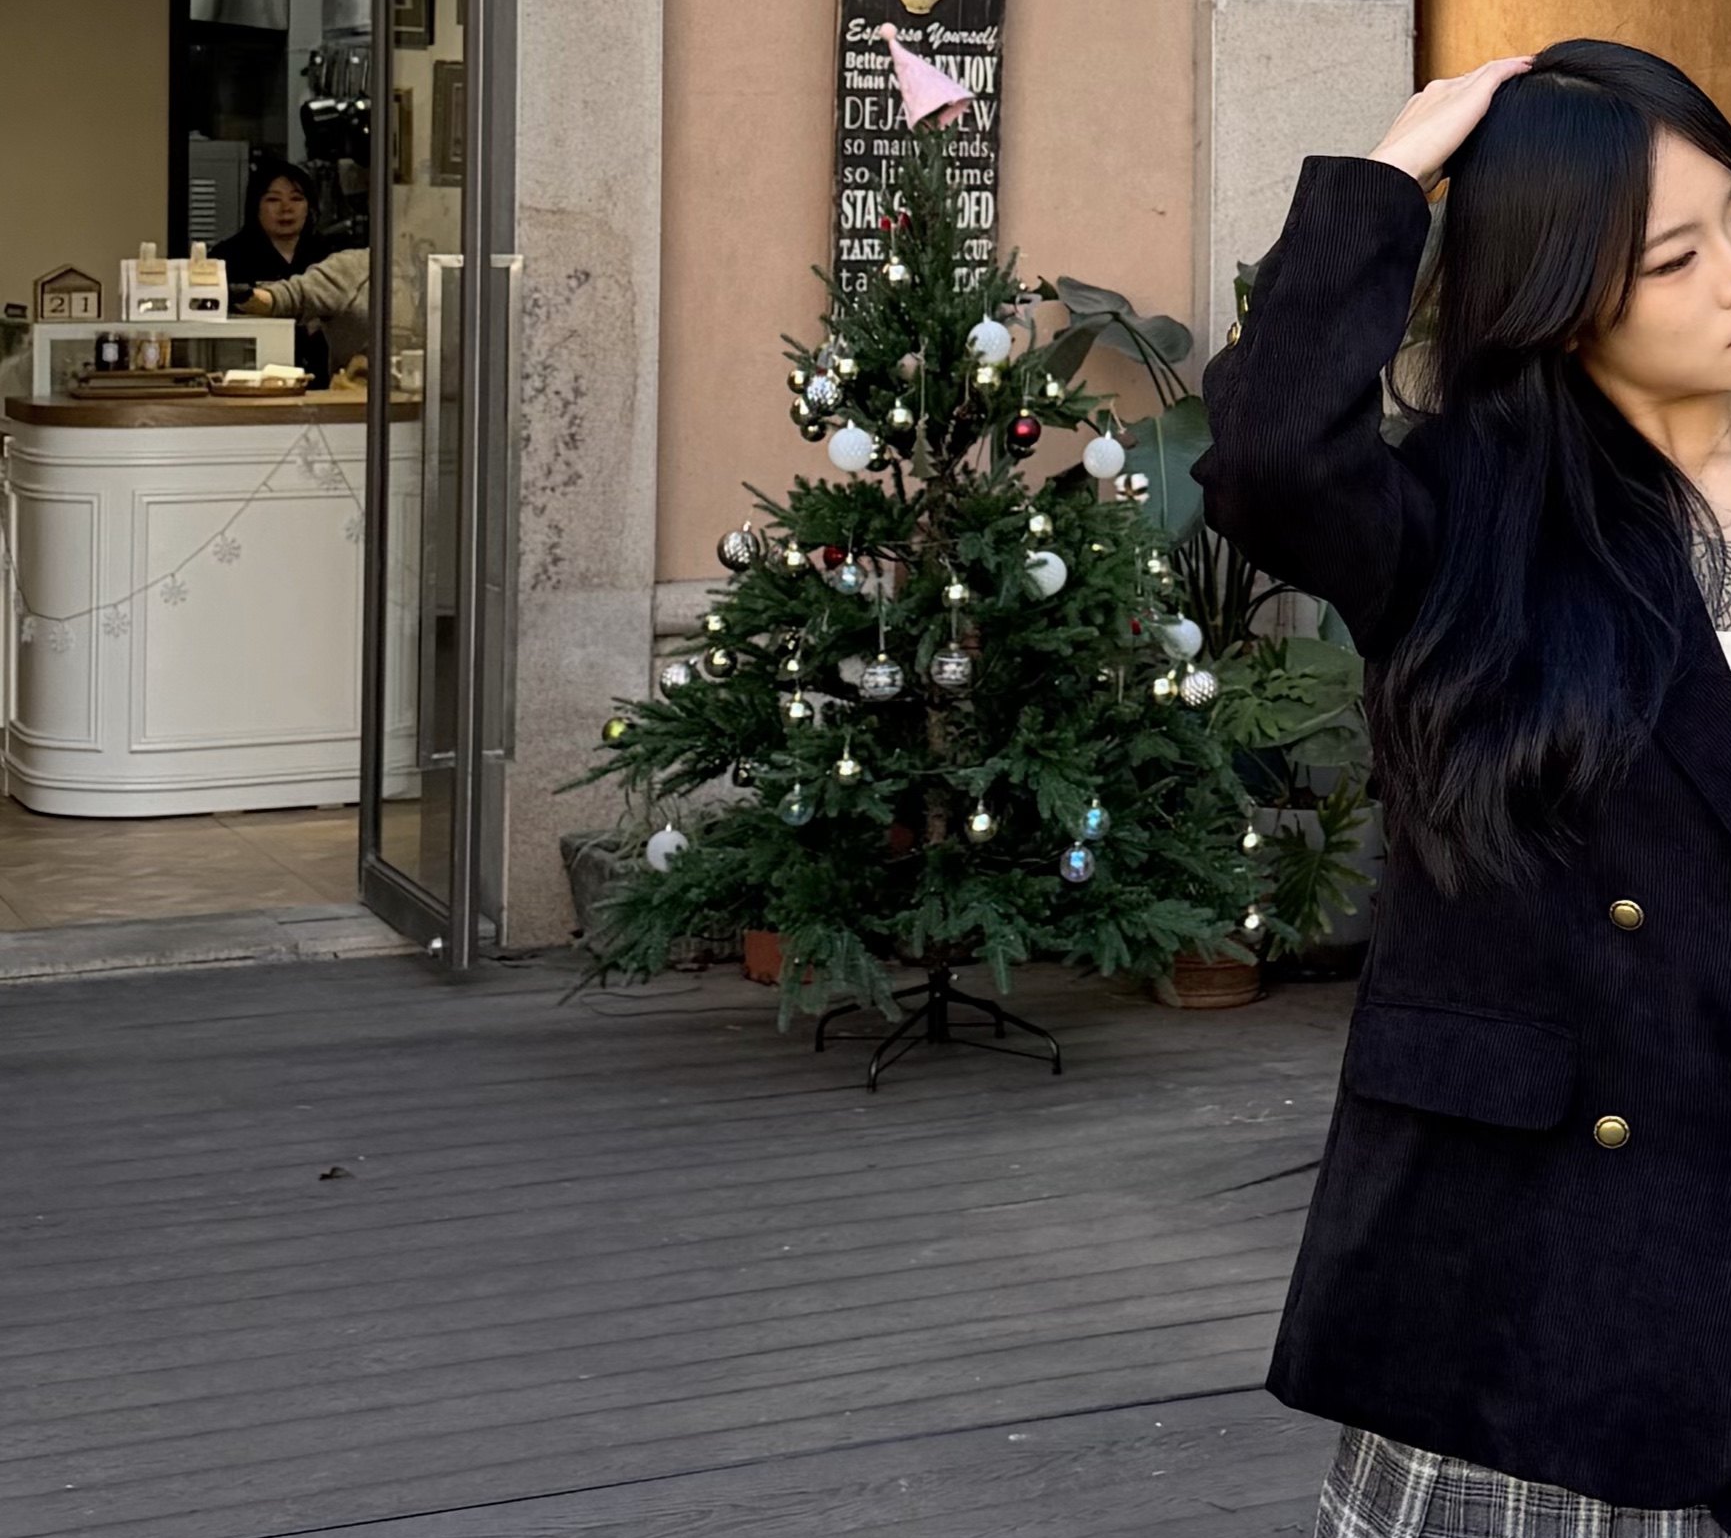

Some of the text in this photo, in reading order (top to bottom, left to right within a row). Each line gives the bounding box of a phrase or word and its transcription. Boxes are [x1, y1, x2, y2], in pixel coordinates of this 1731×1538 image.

[846, 18, 999, 51] Espsso Yourself
[845, 51, 892, 69] Better
[844, 70, 884, 90] Than
[843, 138, 866, 155] so
[843, 166, 870, 184] so
[945, 162, 995, 185] time
[839, 238, 885, 260] TAKE
